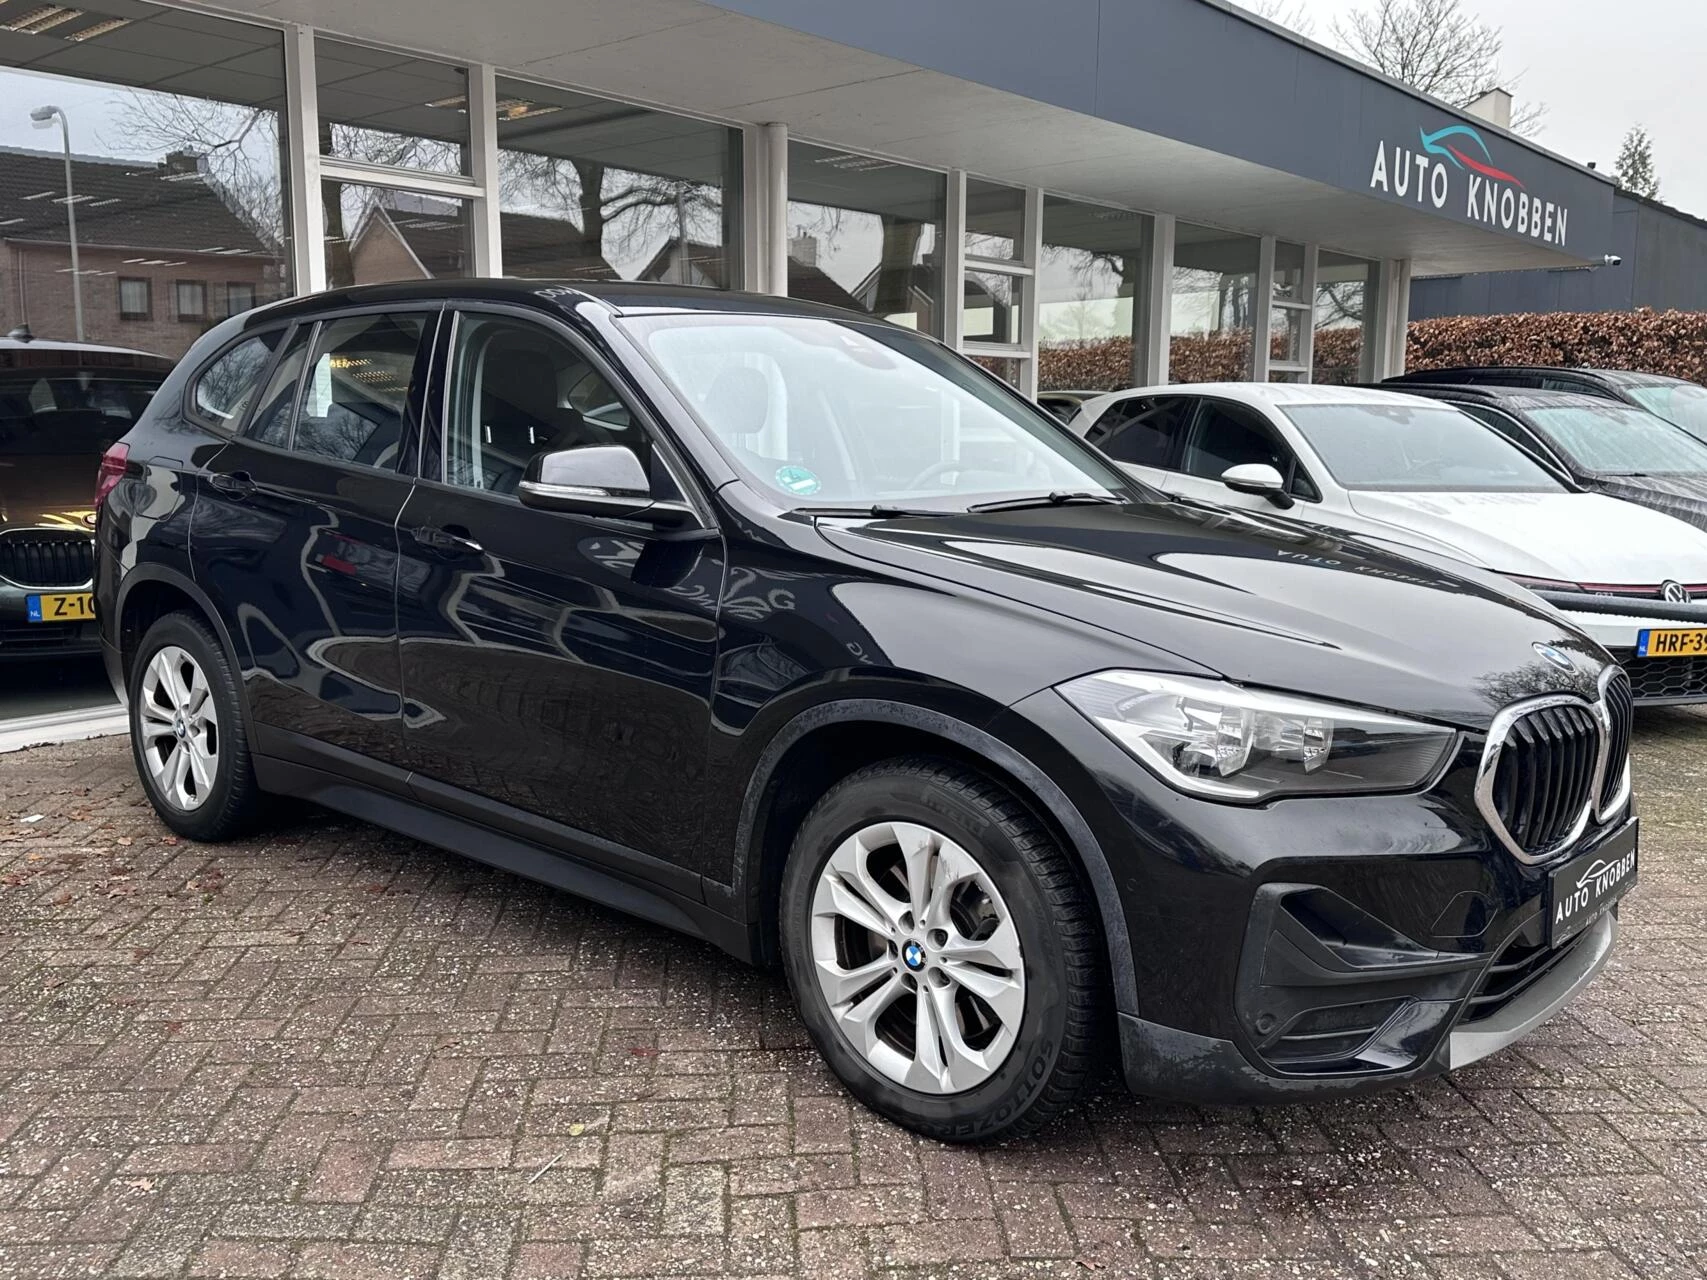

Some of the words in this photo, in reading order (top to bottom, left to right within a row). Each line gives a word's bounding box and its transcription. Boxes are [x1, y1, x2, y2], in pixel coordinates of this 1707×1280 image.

[1370, 140, 1448, 209] AUTO
[1466, 174, 1568, 247] KNOBBEN
[1655, 633, 1707, 653] HRF-3
[1555, 887, 1589, 924] AUTO
[1595, 848, 1635, 898] KNOBBEN
